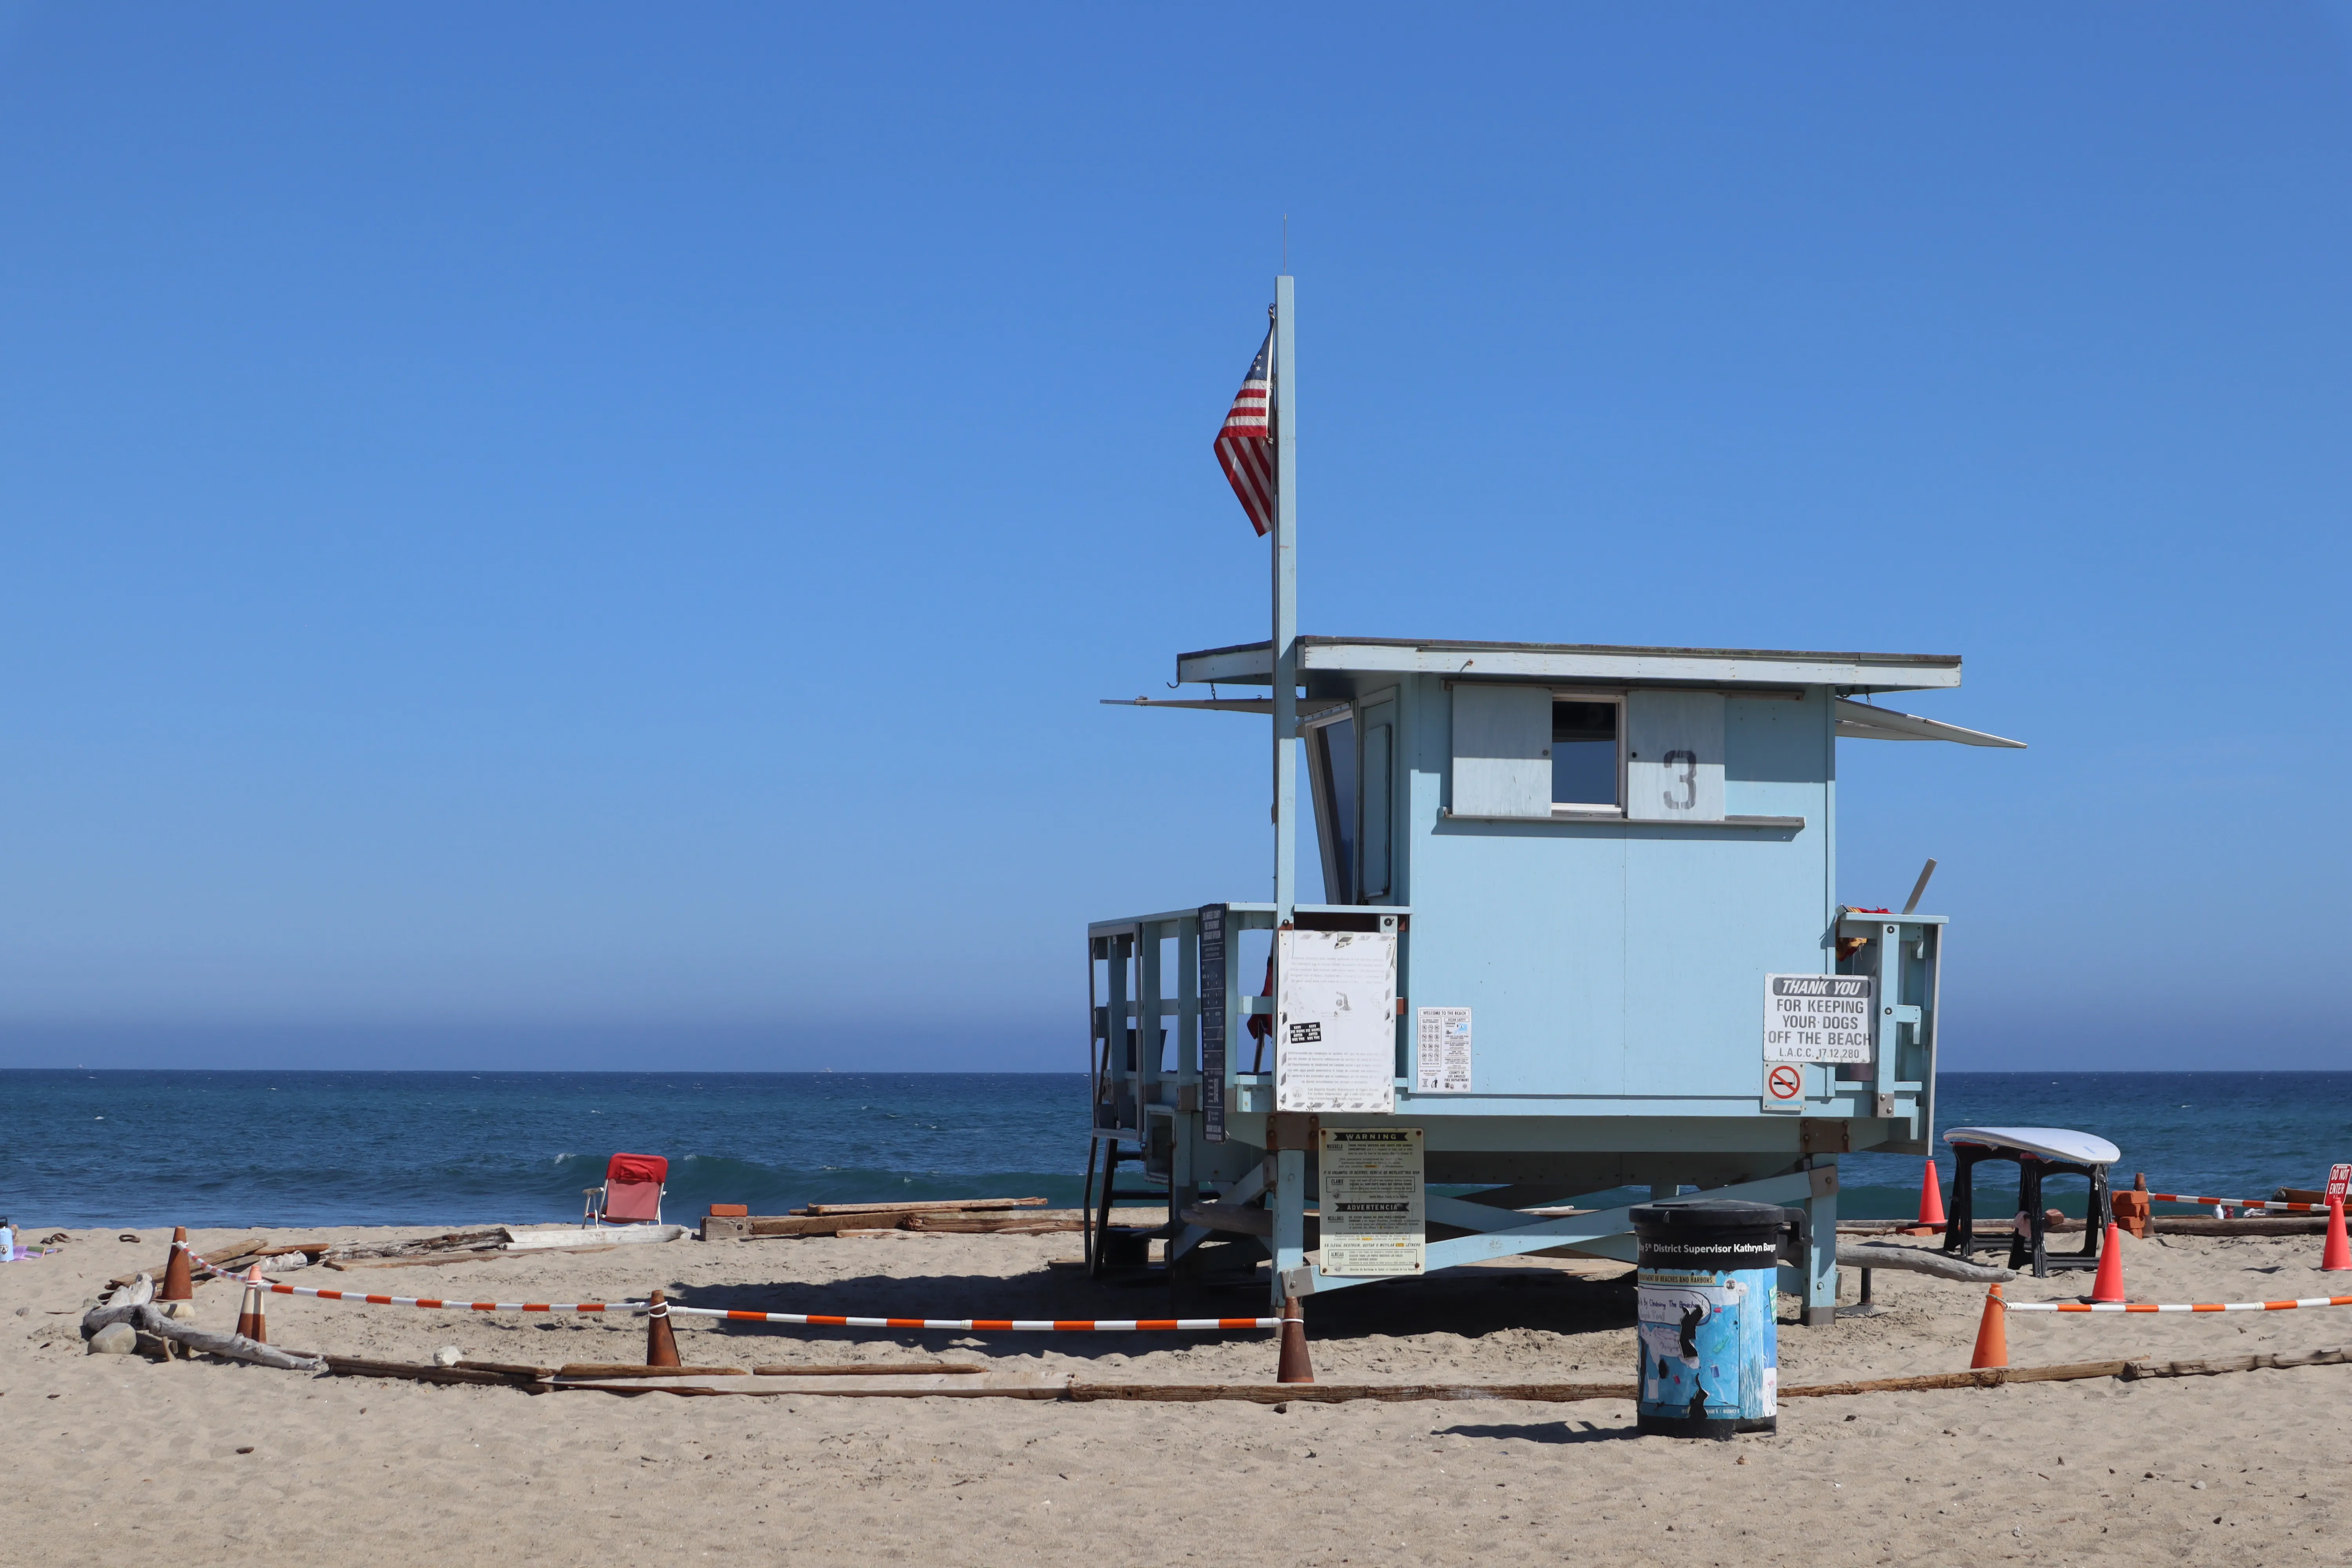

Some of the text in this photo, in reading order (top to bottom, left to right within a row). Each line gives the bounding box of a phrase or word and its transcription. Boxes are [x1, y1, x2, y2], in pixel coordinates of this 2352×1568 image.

[1663, 750, 1697, 809] 3
[1782, 980, 1861, 995] THANK YOU
[1777, 999, 1864, 1013] FOR KEEPING
[1782, 1015, 1858, 1029] YOUR DOGS
[1768, 1031, 1871, 1046] OFF THE BEACH
[1779, 1048, 1814, 1057] L.A.C.C.
[2331, 1169, 2350, 1180] DO NOT
[2329, 1183, 2345, 1194] ENTER
[1640, 1243, 1644, 1253] by
[1654, 1244, 1681, 1252] District
[1684, 1244, 1732, 1254] Supervisor
[1733, 1243, 1762, 1254] Kathryn
[1763, 1243, 1776, 1253] Barger
[1650, 1299, 1666, 1310] Cleaning
[1669, 1299, 1677, 1308] The
